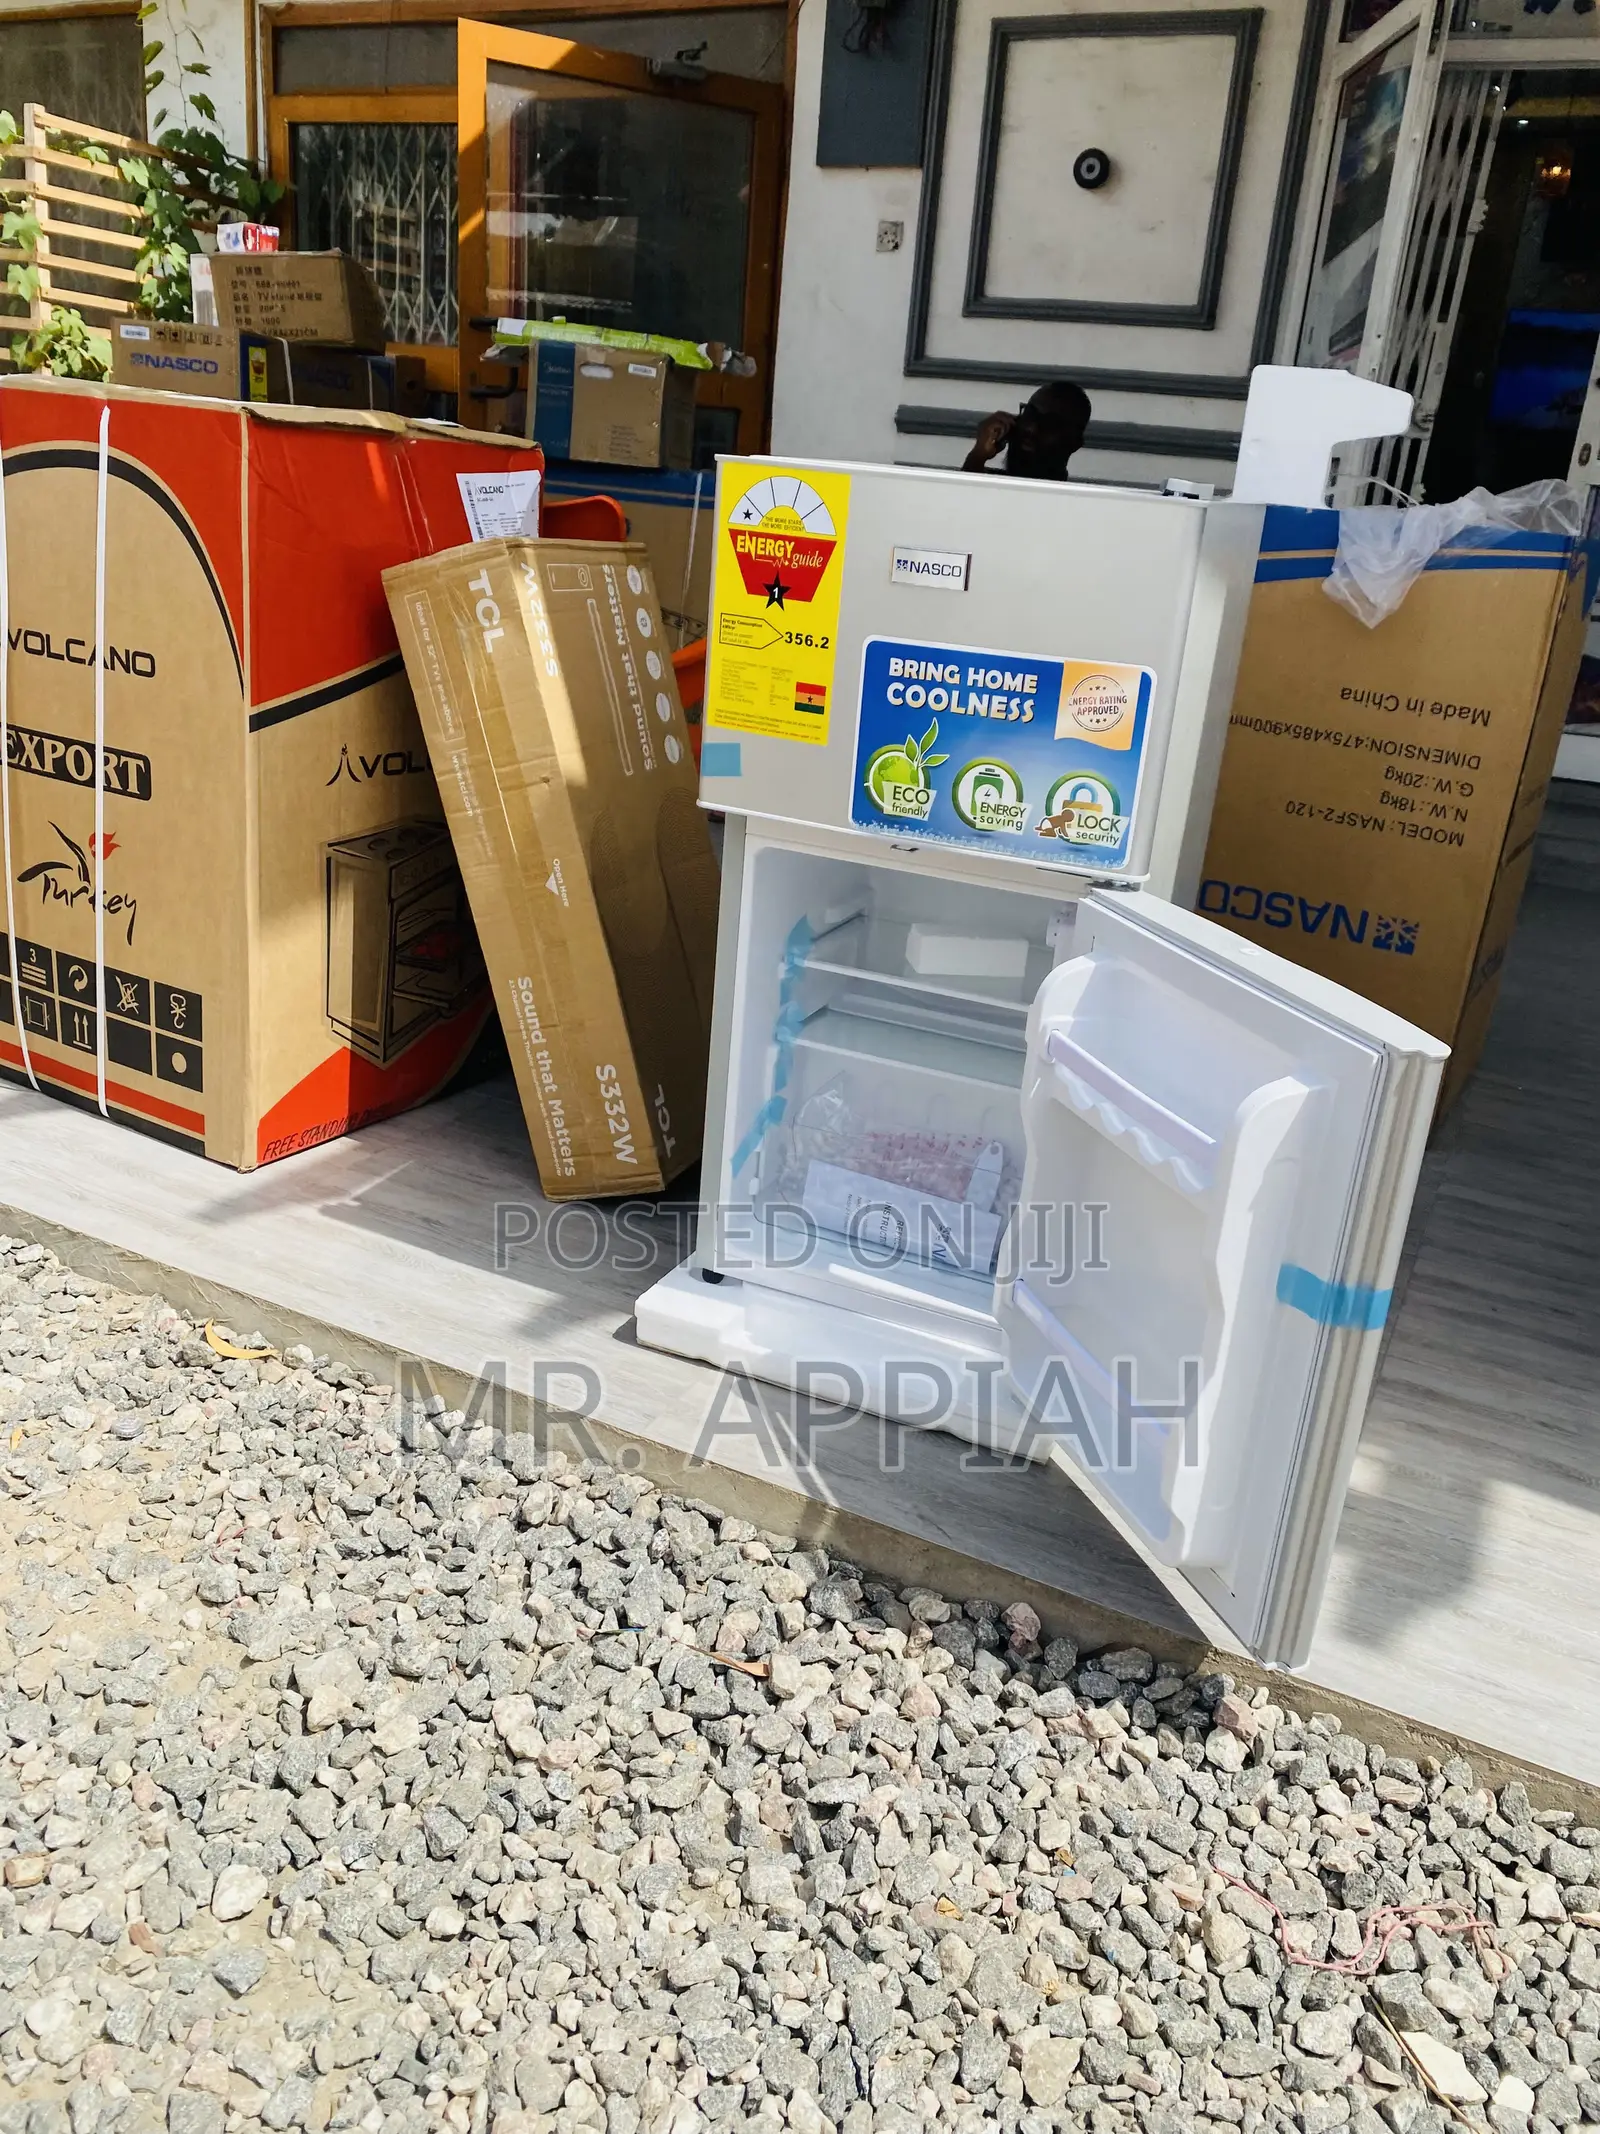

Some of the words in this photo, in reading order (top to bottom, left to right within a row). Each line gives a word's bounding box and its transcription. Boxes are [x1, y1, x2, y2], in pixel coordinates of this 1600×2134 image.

[144, 354, 219, 375] NASCO
[479, 485, 504, 495] VOLCANO
[736, 531, 795, 561] ENERGY
[791, 551, 823, 568] guide
[909, 560, 962, 578] NASCO
[601, 564, 628, 646] Matters
[773, 587, 779, 598] 1
[468, 568, 504, 653] TCL
[520, 562, 559, 677] S332W
[7, 627, 156, 679] VOLCANO
[784, 631, 830, 649] 356.2
[621, 652, 637, 696] that
[889, 657, 960, 685] BRING
[967, 667, 1038, 694] HOME
[887, 682, 1035, 723] COOLNESS
[1068, 695, 1097, 706] ENERGY
[1099, 695, 1128, 705] RATING
[1077, 705, 1119, 717] APPROVED
[1339, 686, 1400, 713] China
[1405, 697, 1425, 718] in
[441, 703, 456, 734] above
[1428, 701, 1491, 727] Made
[631, 704, 654, 770] Sound
[358, 750, 433, 778] VOL
[451, 754, 475, 818] www.tcl.com
[892, 785, 930, 805] ECO
[891, 801, 929, 819] friendly
[980, 802, 1027, 819] ENERGY
[980, 814, 1023, 831] saving
[1077, 813, 1120, 833] LOCK
[1284, 800, 1387, 832] NASF2-120
[1076, 829, 1120, 846] security
[1389, 819, 1465, 847] MODEL:
[552, 858, 564, 885] Open
[559, 885, 570, 907] Here
[1200, 880, 1370, 944] NASCO
[29, 948, 37, 962] 3
[517, 976, 545, 1044] Sound
[535, 1050, 559, 1093] that
[548, 1099, 576, 1177] Matters
[596, 1063, 638, 1165] S332W
[654, 1084, 676, 1158] TCL
[263, 1132, 299, 1160] FREE
